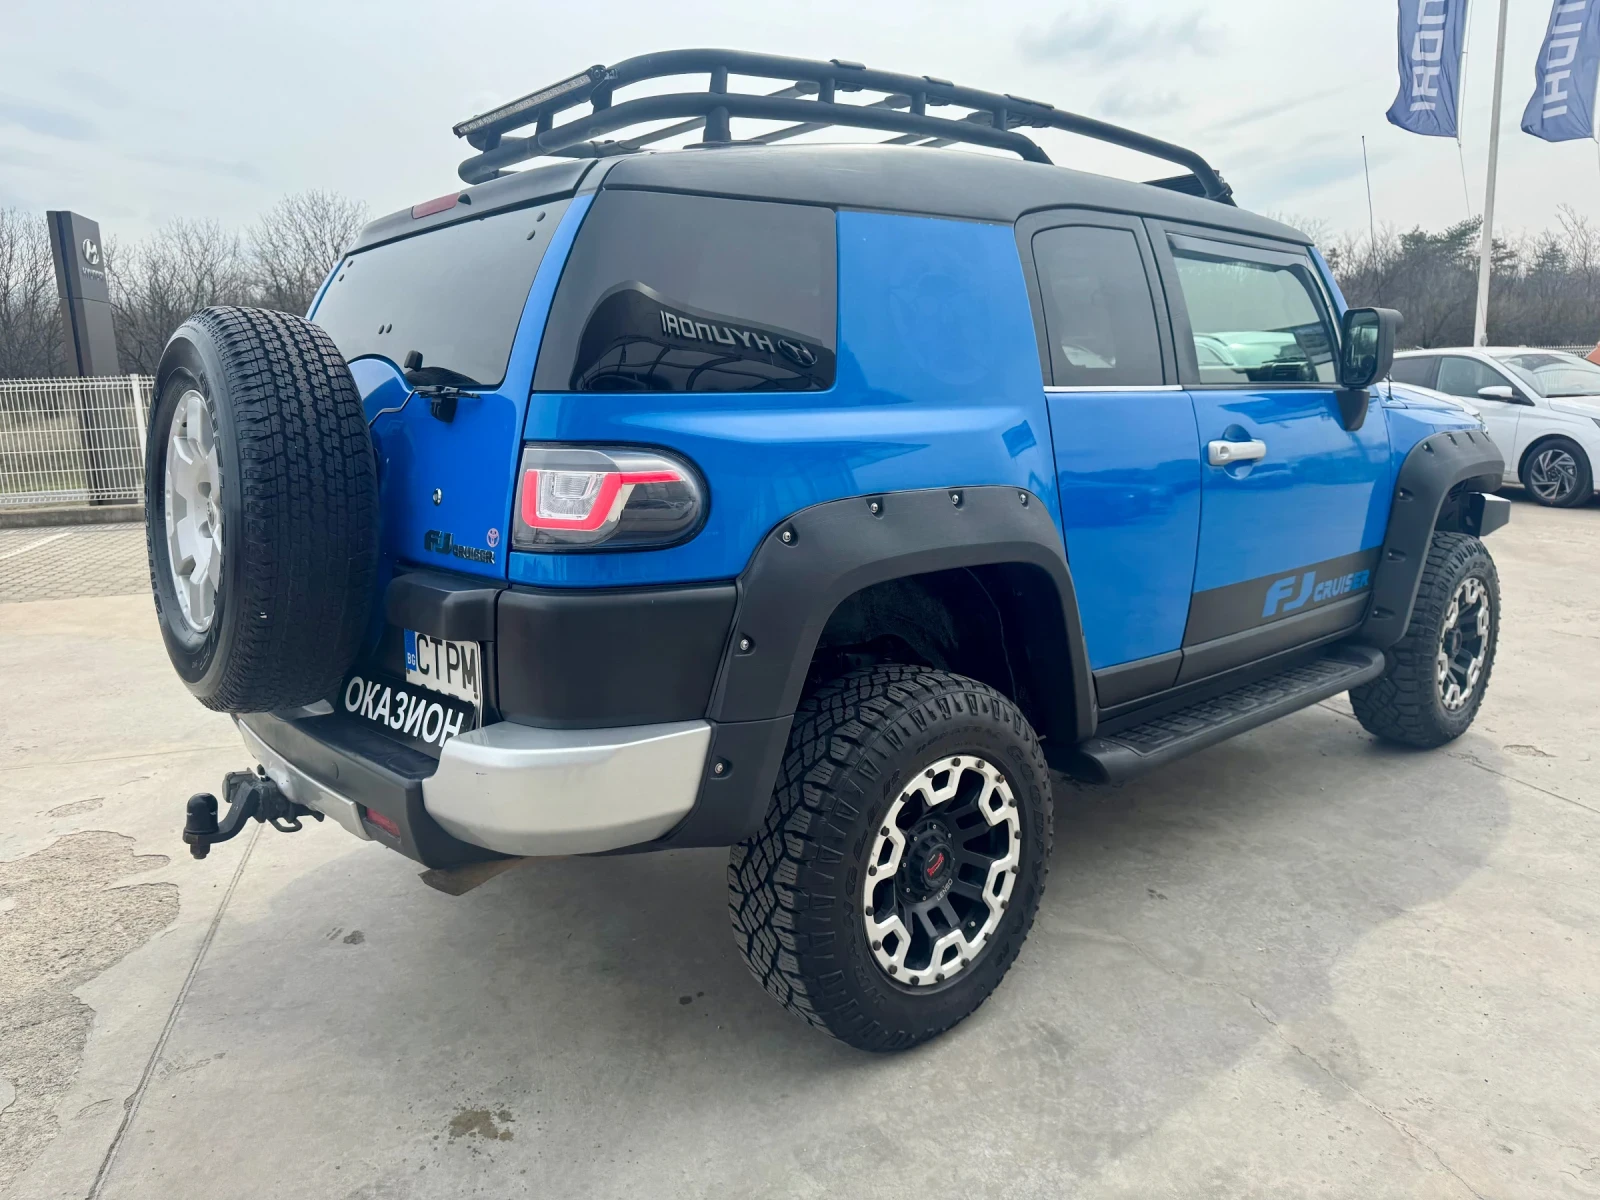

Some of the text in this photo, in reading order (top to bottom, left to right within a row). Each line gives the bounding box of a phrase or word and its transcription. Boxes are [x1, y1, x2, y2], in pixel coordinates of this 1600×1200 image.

[424, 529, 495, 564] FJ CRUISER
[1262, 569, 1370, 618] FJ CRUISER
[407, 652, 416, 666] BG
[345, 676, 464, 748] ОКАЗИОН
[936, 878, 953, 901] LENSO
